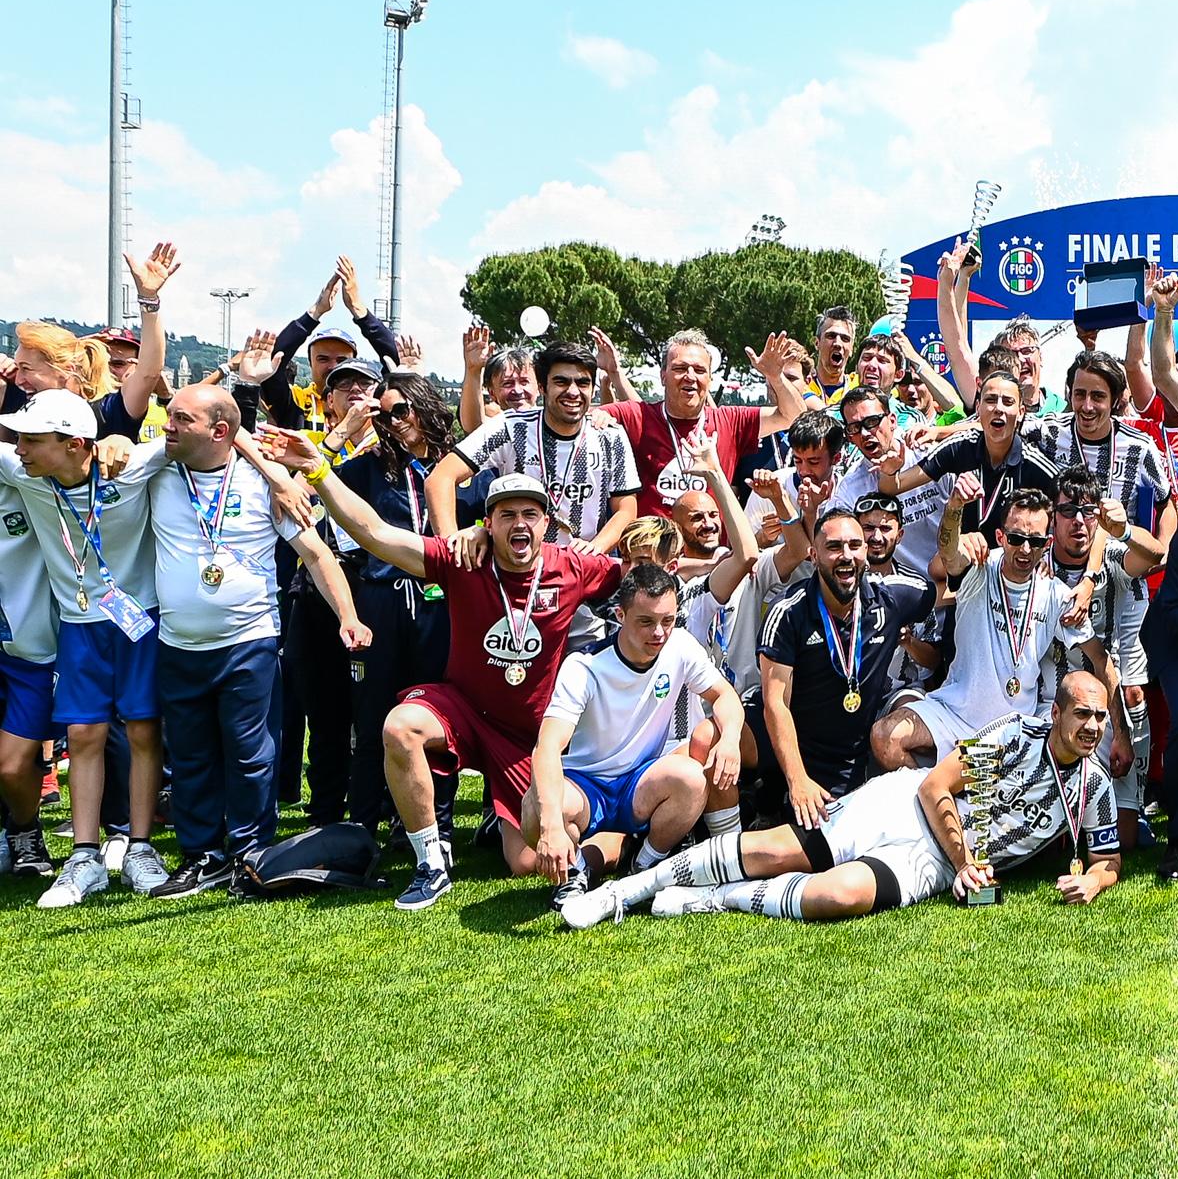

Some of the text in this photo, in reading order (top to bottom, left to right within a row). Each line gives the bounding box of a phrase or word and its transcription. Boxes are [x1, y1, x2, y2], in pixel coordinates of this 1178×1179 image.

[1067, 233, 1161, 263] FINALE
[1009, 263, 1034, 276] FIGC
[927, 352, 946, 362] FIGC
[547, 478, 594, 504] eep
[997, 784, 1054, 831] Jeep
